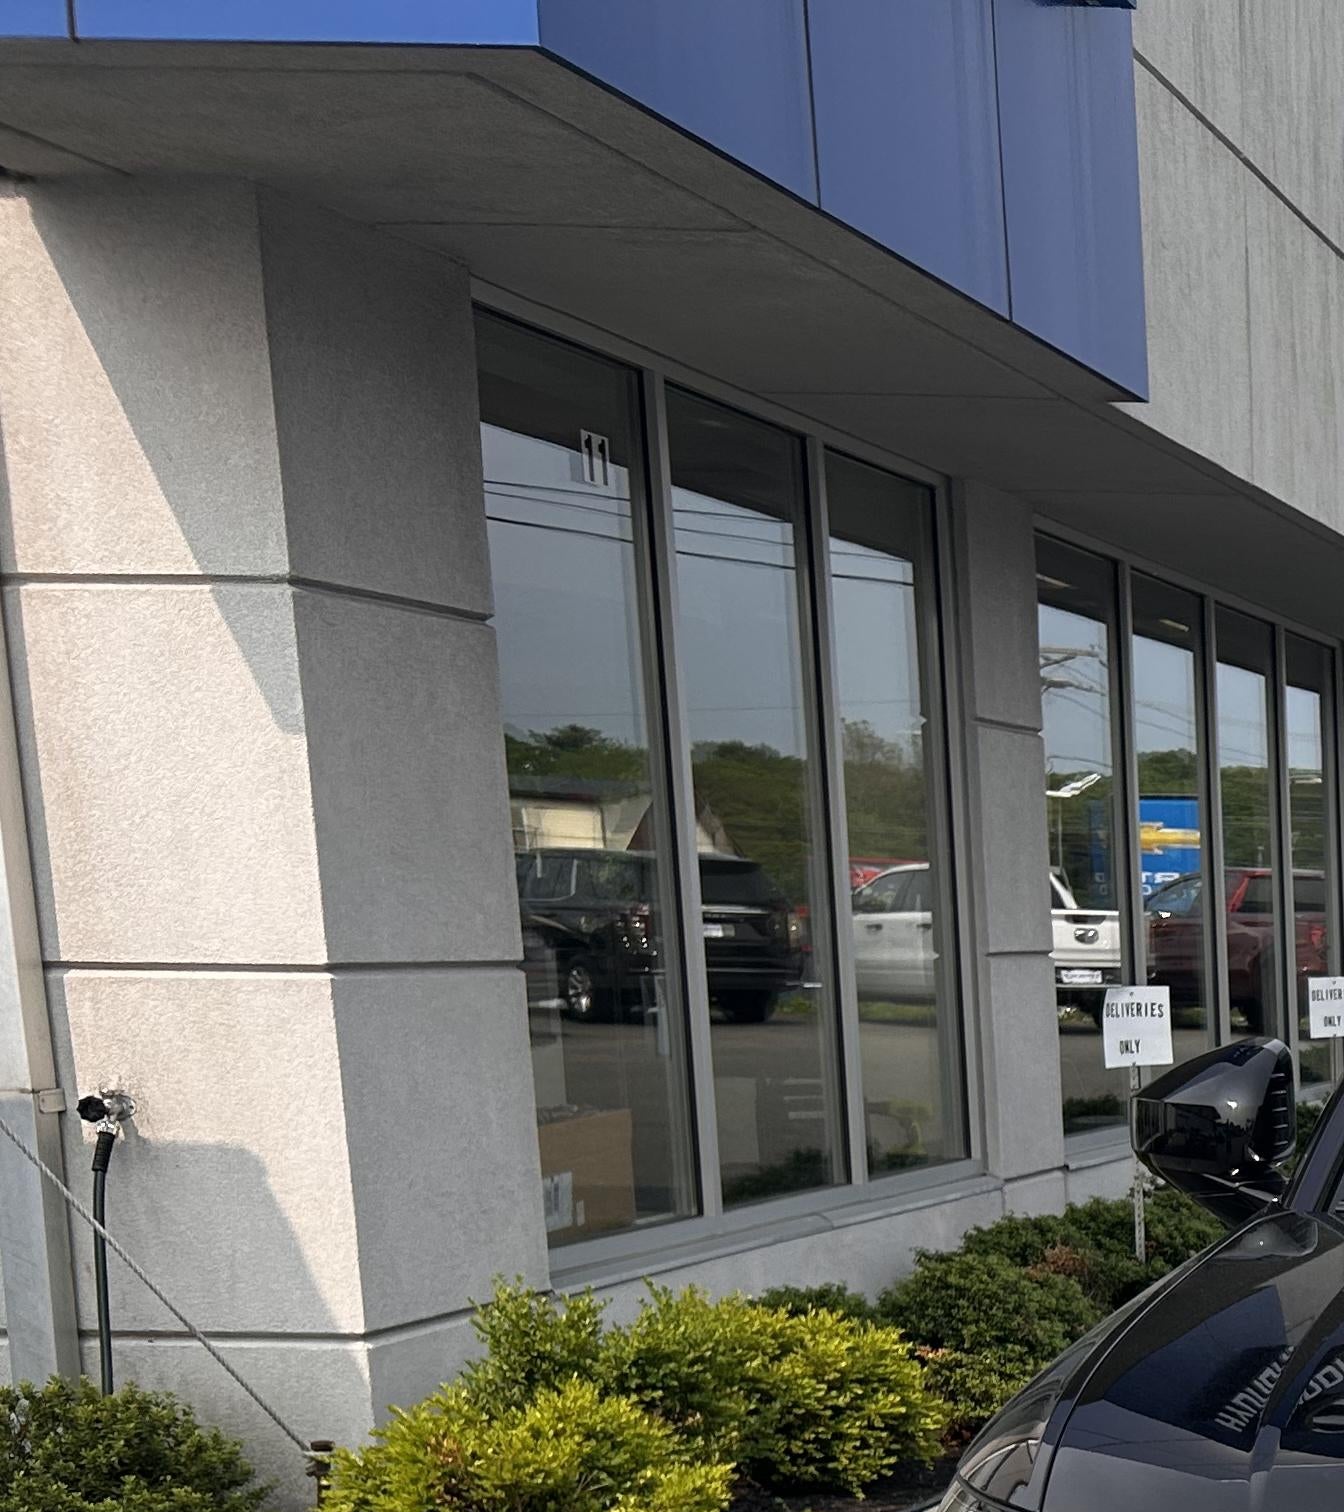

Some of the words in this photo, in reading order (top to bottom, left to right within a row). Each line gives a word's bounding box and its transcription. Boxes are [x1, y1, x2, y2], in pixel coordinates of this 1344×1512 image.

[584, 434, 609, 486] 11
[1105, 1002, 1164, 1018] DELIVERIES
[1323, 1015, 1341, 1027] ONLY
[1119, 1039, 1140, 1055] ONLY
